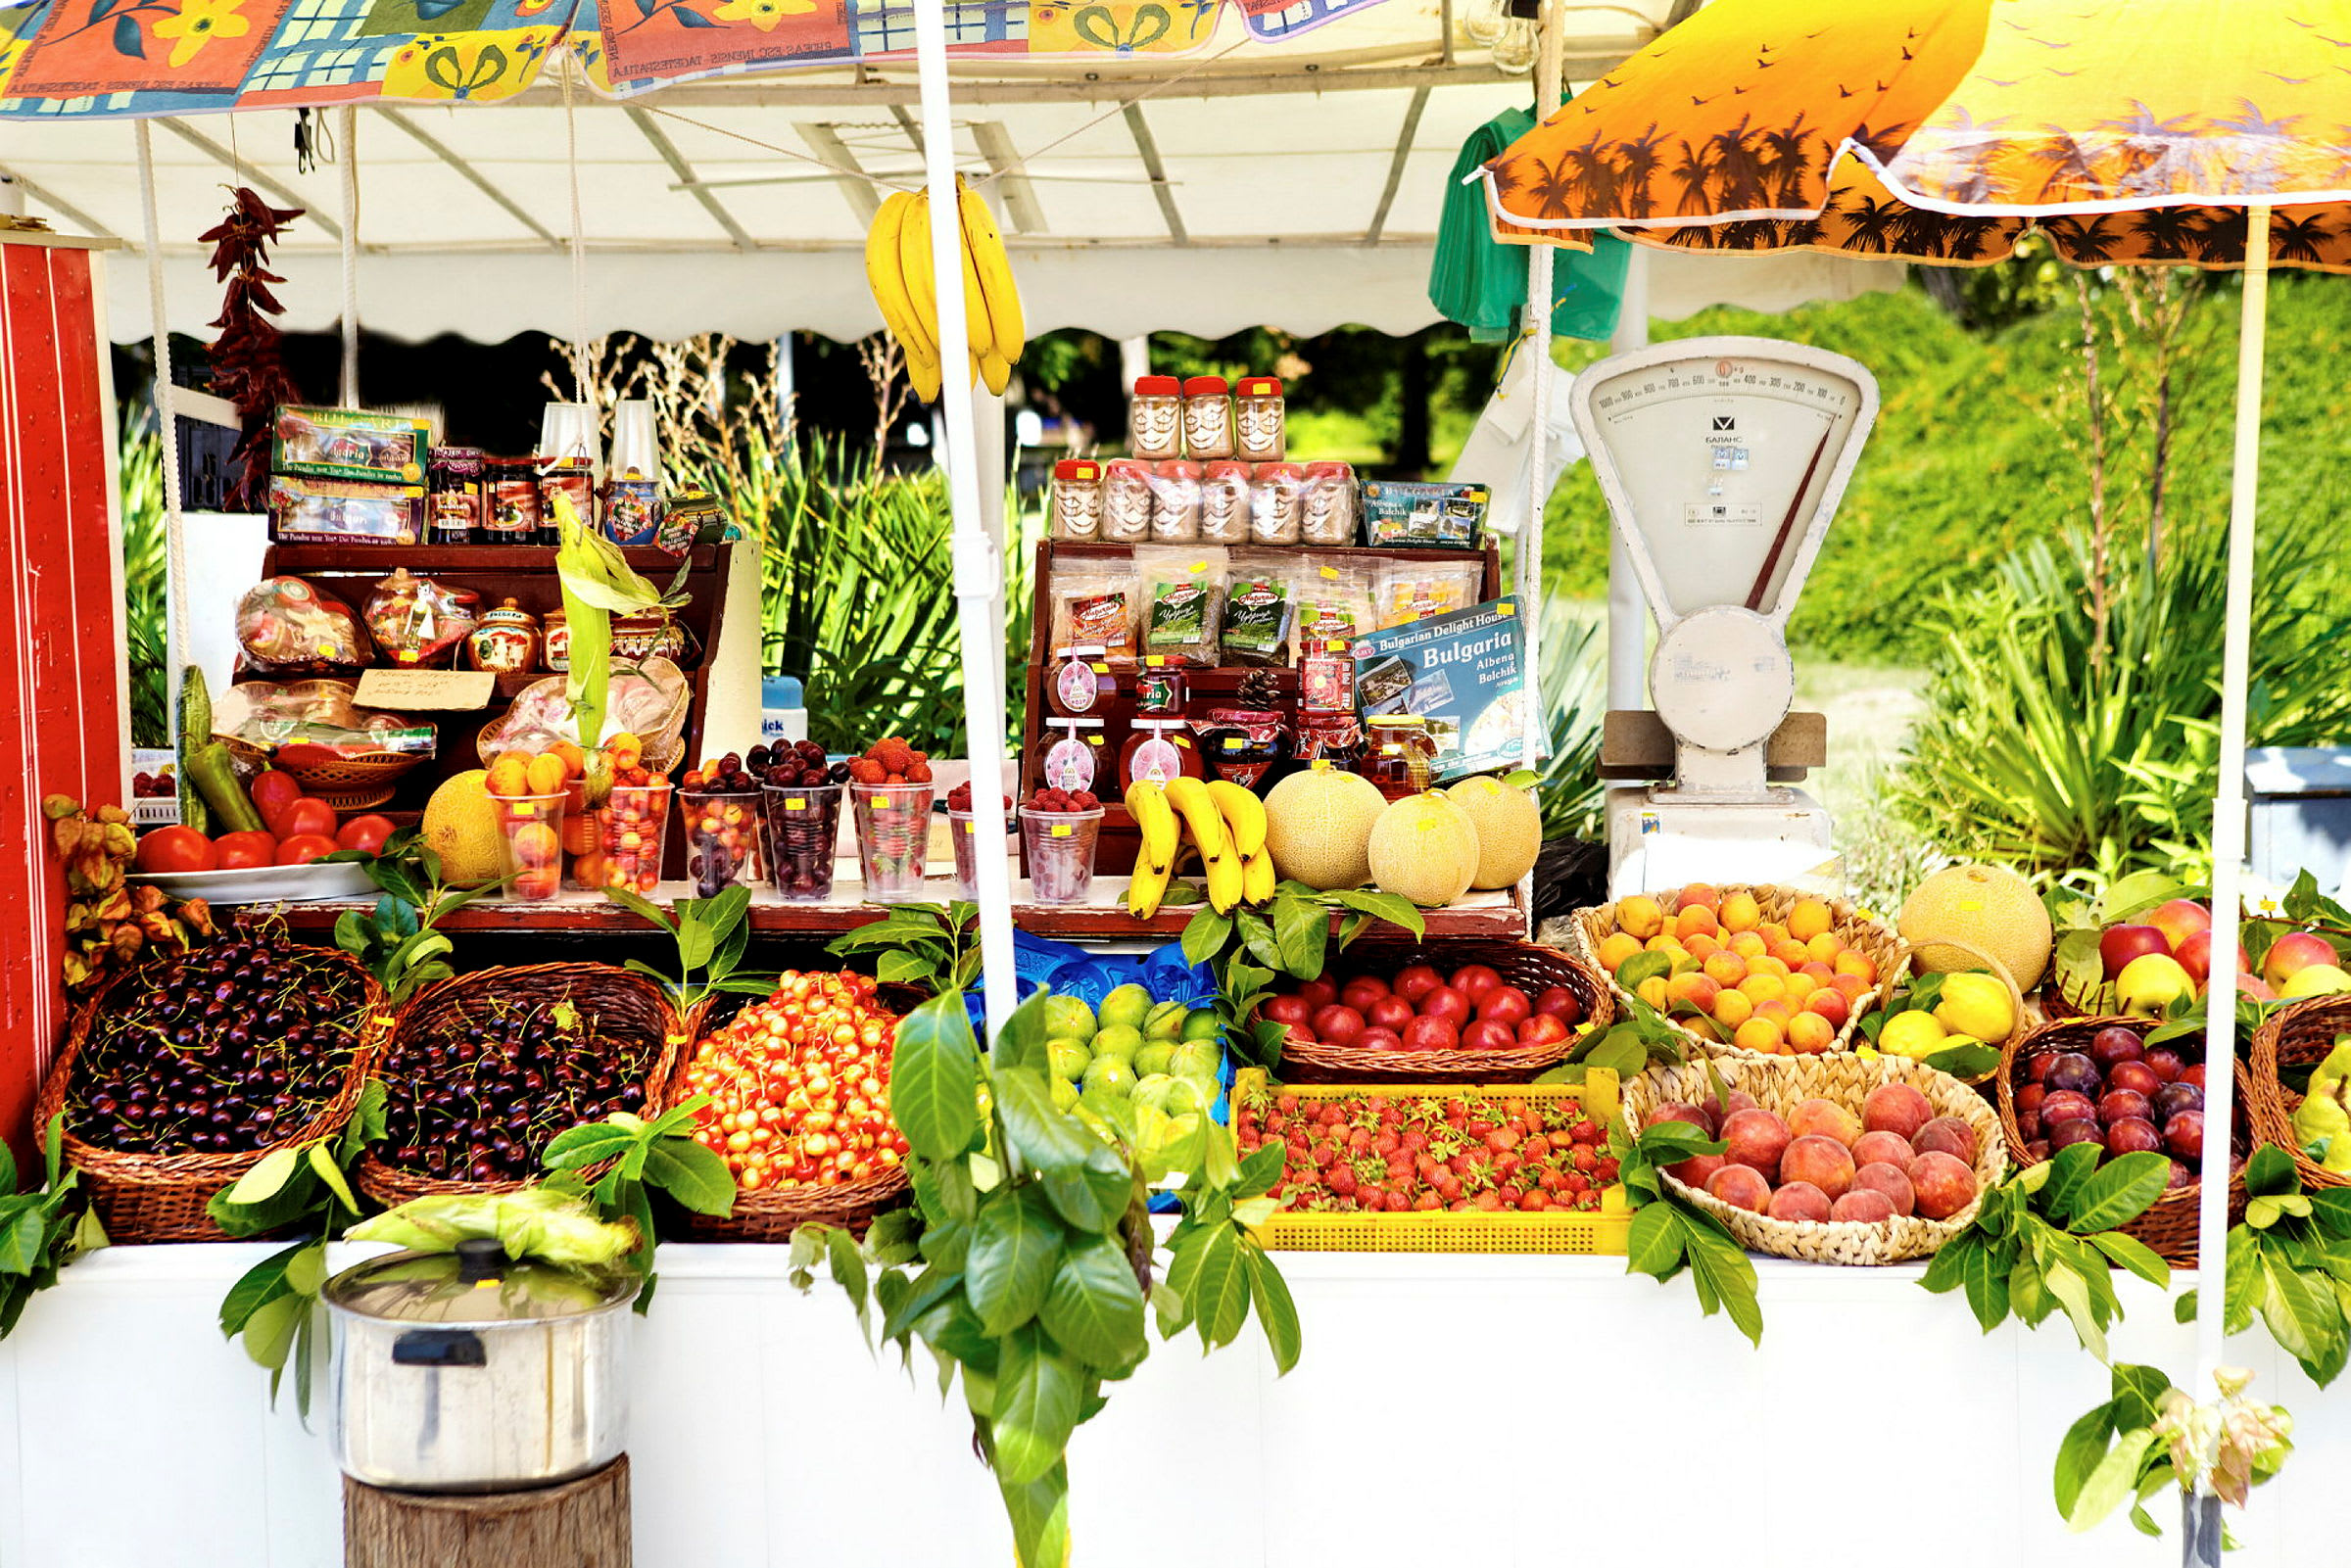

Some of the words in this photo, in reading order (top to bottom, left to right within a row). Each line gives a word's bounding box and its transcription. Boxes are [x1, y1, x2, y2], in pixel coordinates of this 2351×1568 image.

[1744, 374, 1756, 384] 400
[1379, 630, 1432, 652] Bulgarian
[1433, 619, 1475, 638] Delight
[1422, 631, 1512, 670] Bulgaria
[1476, 653, 1515, 671] Albena
[1478, 665, 1517, 686] Balchik
[762, 718, 785, 732] ick
